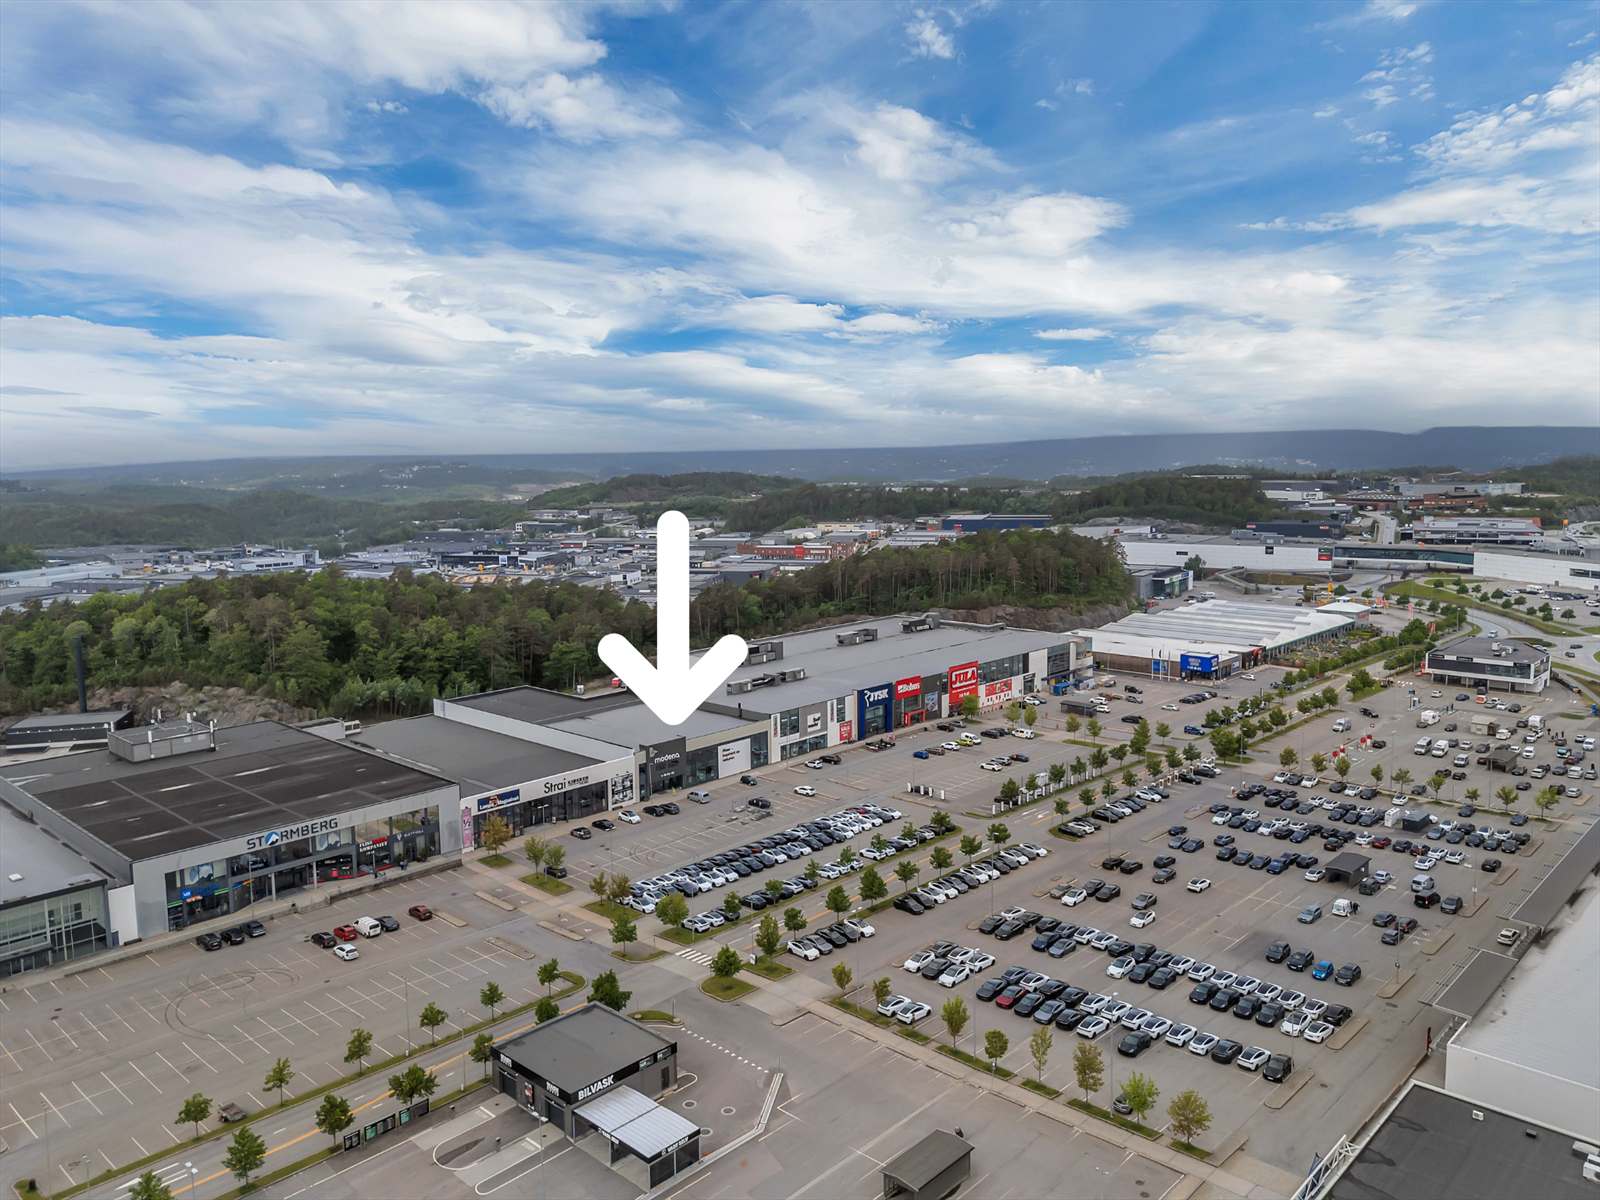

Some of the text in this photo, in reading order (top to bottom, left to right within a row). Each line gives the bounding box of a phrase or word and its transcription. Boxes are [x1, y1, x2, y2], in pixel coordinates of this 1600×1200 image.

[952, 669, 977, 685] JULA
[869, 689, 889, 702] JYSK
[654, 752, 681, 764] modena
[544, 778, 566, 794] Strai
[247, 818, 338, 850] STORMBERG
[578, 1075, 614, 1100] BILVASK
